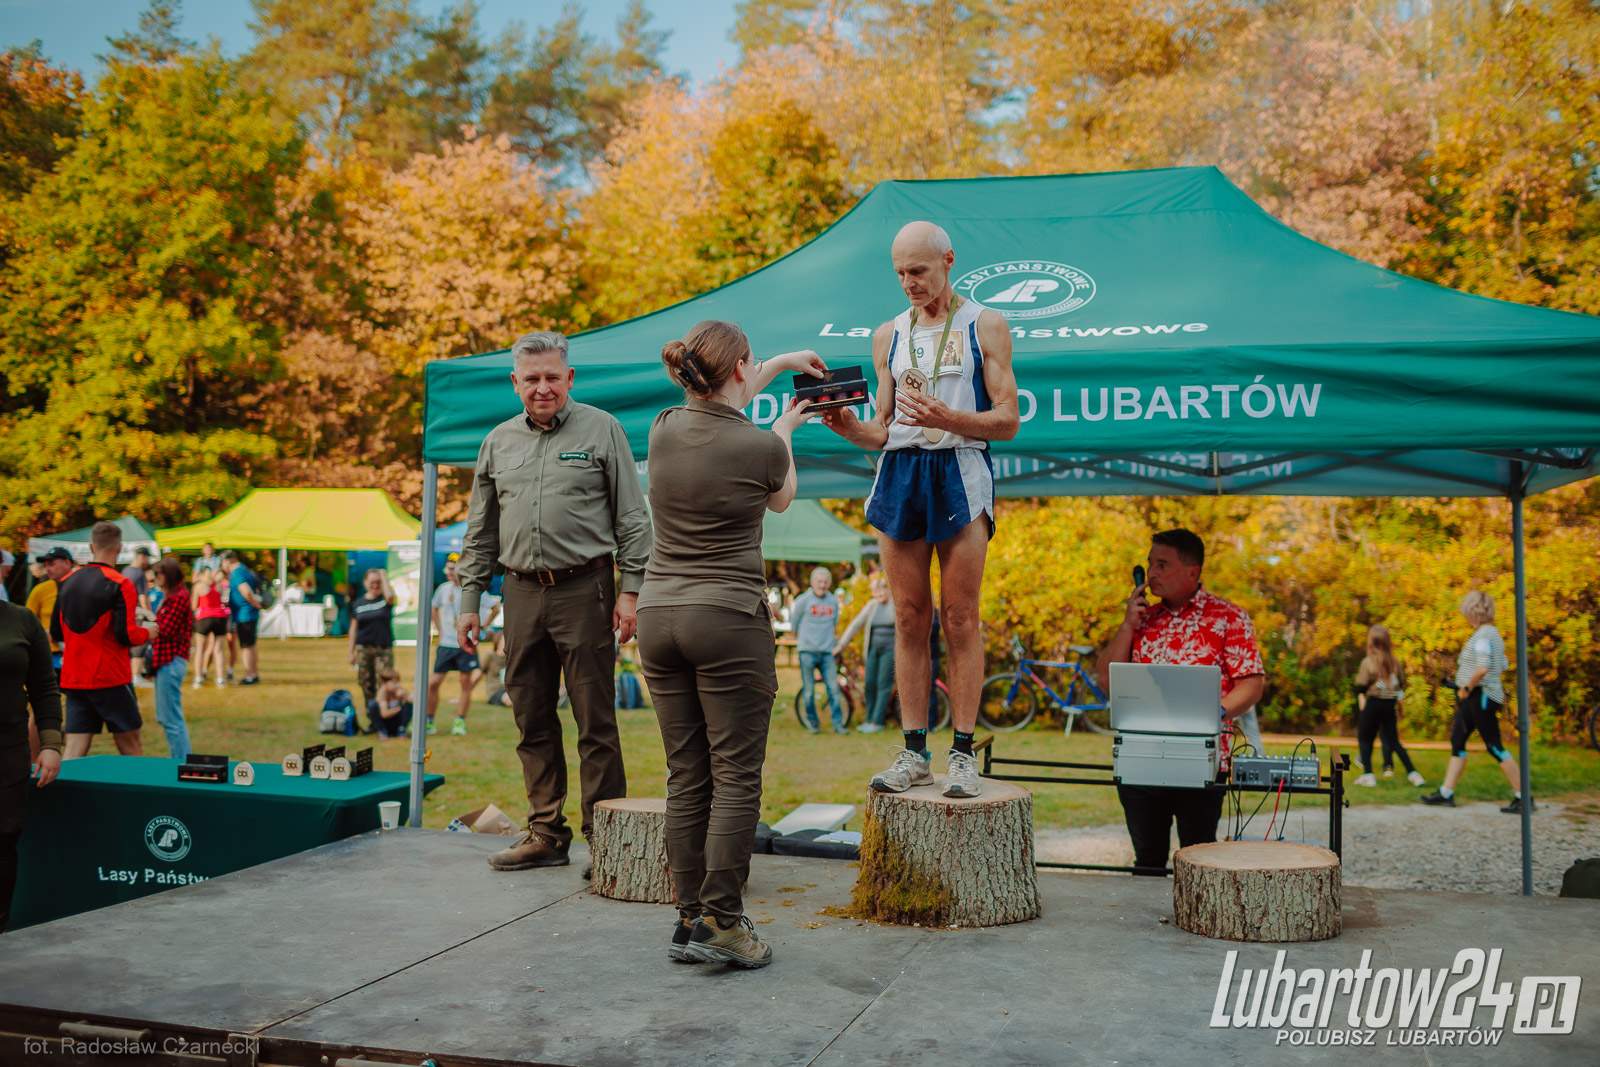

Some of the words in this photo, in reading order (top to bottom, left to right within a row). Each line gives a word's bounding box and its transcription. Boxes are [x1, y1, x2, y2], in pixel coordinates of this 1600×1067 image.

[957, 269, 992, 291] LASY
[818, 323, 873, 337] La
[1010, 322, 1209, 338] ństwowe
[1053, 375, 1323, 422] LUBARTÓW
[98, 866, 138, 885] Lasy
[144, 868, 209, 885] Państw
